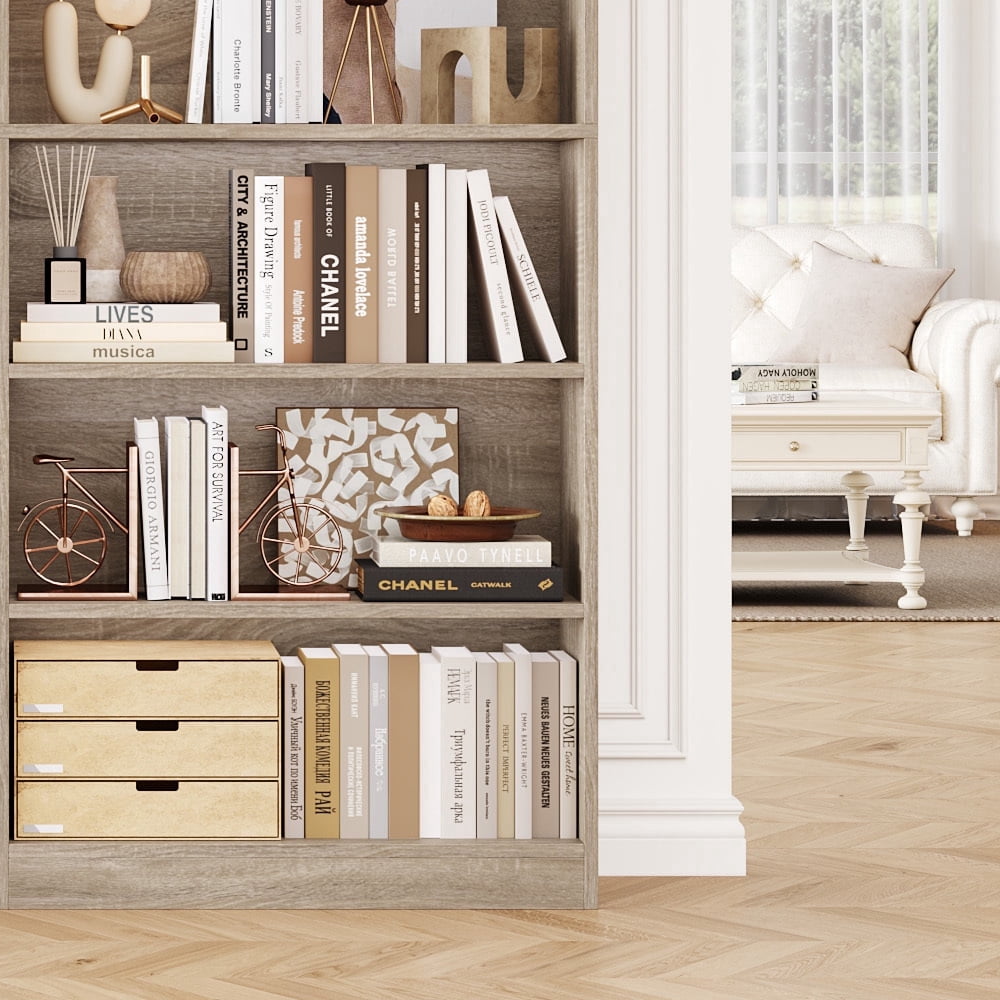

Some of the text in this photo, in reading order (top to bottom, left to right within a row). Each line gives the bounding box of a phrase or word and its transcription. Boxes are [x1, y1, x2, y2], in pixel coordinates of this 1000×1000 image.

[295, 3, 303, 36] BOVARY
[233, 39, 242, 113] Charlotte Bronte
[264, 73, 272, 118] Mary Shelley
[237, 175, 249, 319] CITY & ARCHITECTURE
[260, 184, 279, 279] Figure Drawing
[325, 207, 333, 227] BOOK
[326, 228, 333, 238] OF
[477, 199, 500, 266] JODI PICOULT
[320, 253, 340, 338] CHANEL
[354, 216, 372, 317] amanda lovelace
[516, 253, 541, 303] SCHIELE
[95, 305, 154, 323] LIVES
[92, 344, 155, 359] musica
[758, 368, 817, 377] MOHOLY NAGY
[212, 421, 224, 523] ART FOR SURVIVAL
[144, 451, 161, 571] GIORGIO ARMANI
[378, 579, 459, 591] CHANEL
[409, 547, 545, 562] PAAVO TYNELL
[315, 680, 336, 815] БОЖЕСТВЕННАЯ КОМЕДИЯ РАЙ
[450, 729, 468, 824] Триумфальная арка
[520, 712, 528, 789] EMMA BAXTER-WRIGHT
[541, 696, 551, 809] NEUES BAUEN NEUES GESTALTEN
